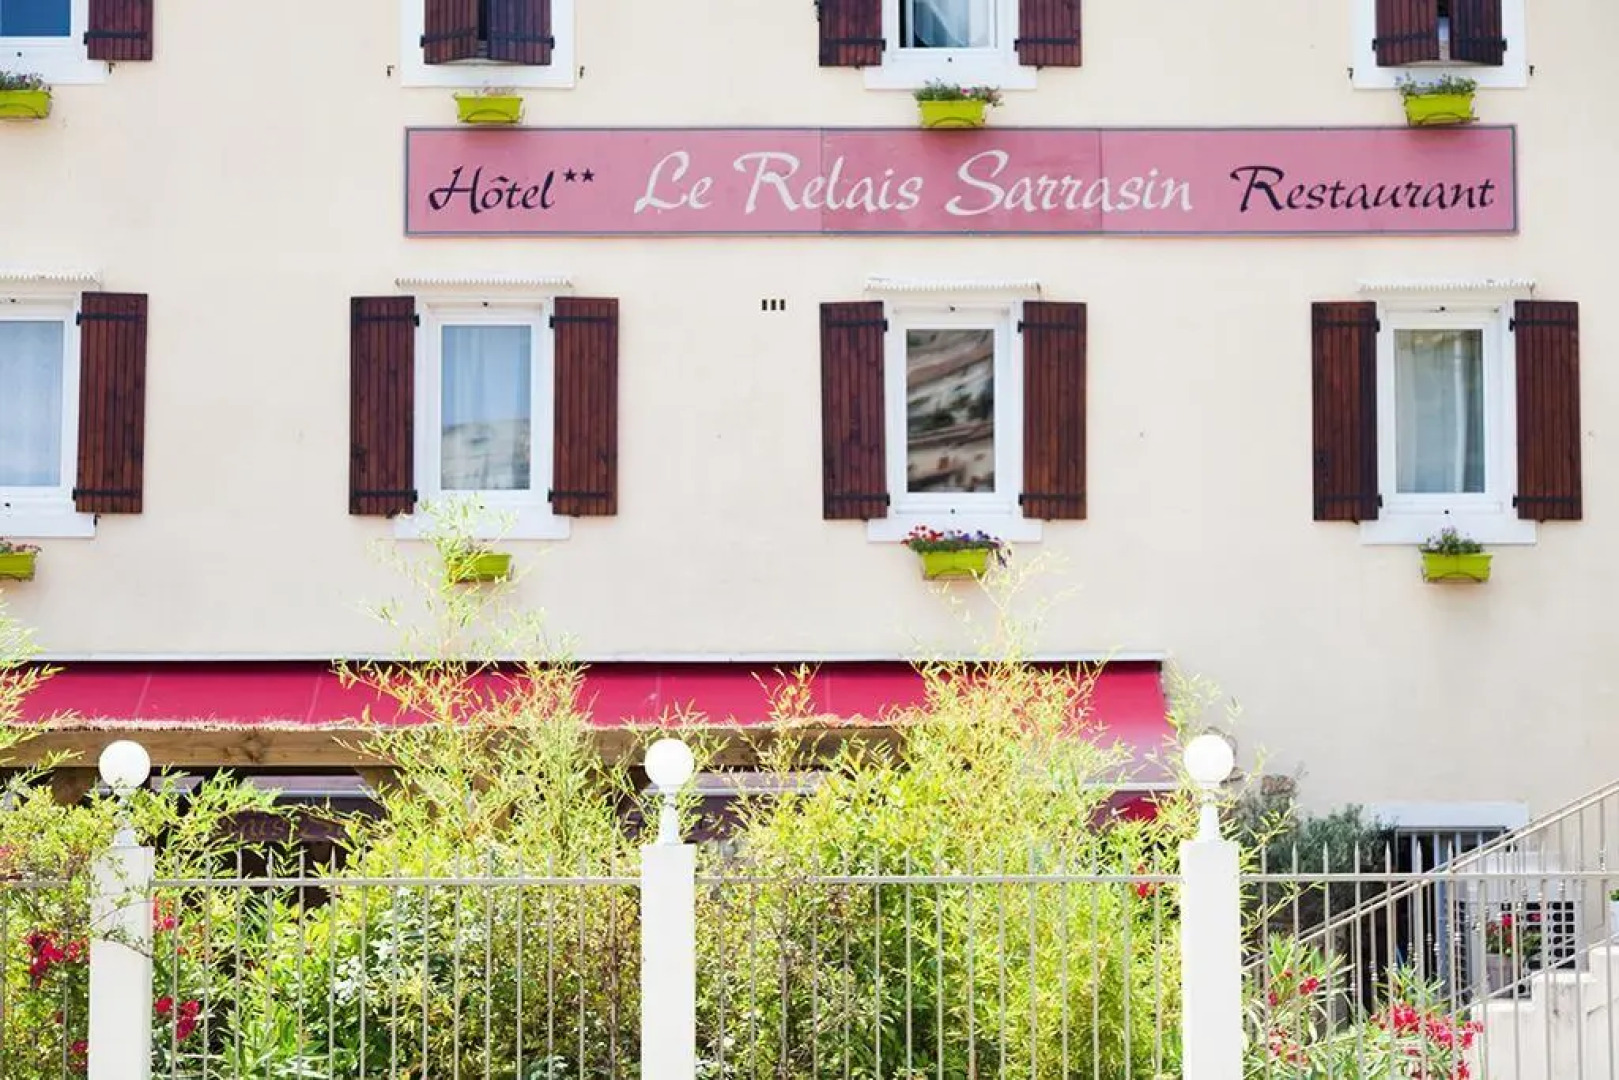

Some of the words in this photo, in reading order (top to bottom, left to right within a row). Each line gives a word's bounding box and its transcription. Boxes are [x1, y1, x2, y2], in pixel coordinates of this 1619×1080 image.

[428, 164, 556, 215] Hôtel
[633, 150, 713, 215] Le
[732, 150, 924, 216] Relais
[945, 149, 1194, 216] Sarrasin
[1229, 164, 1496, 213] Restaurant
